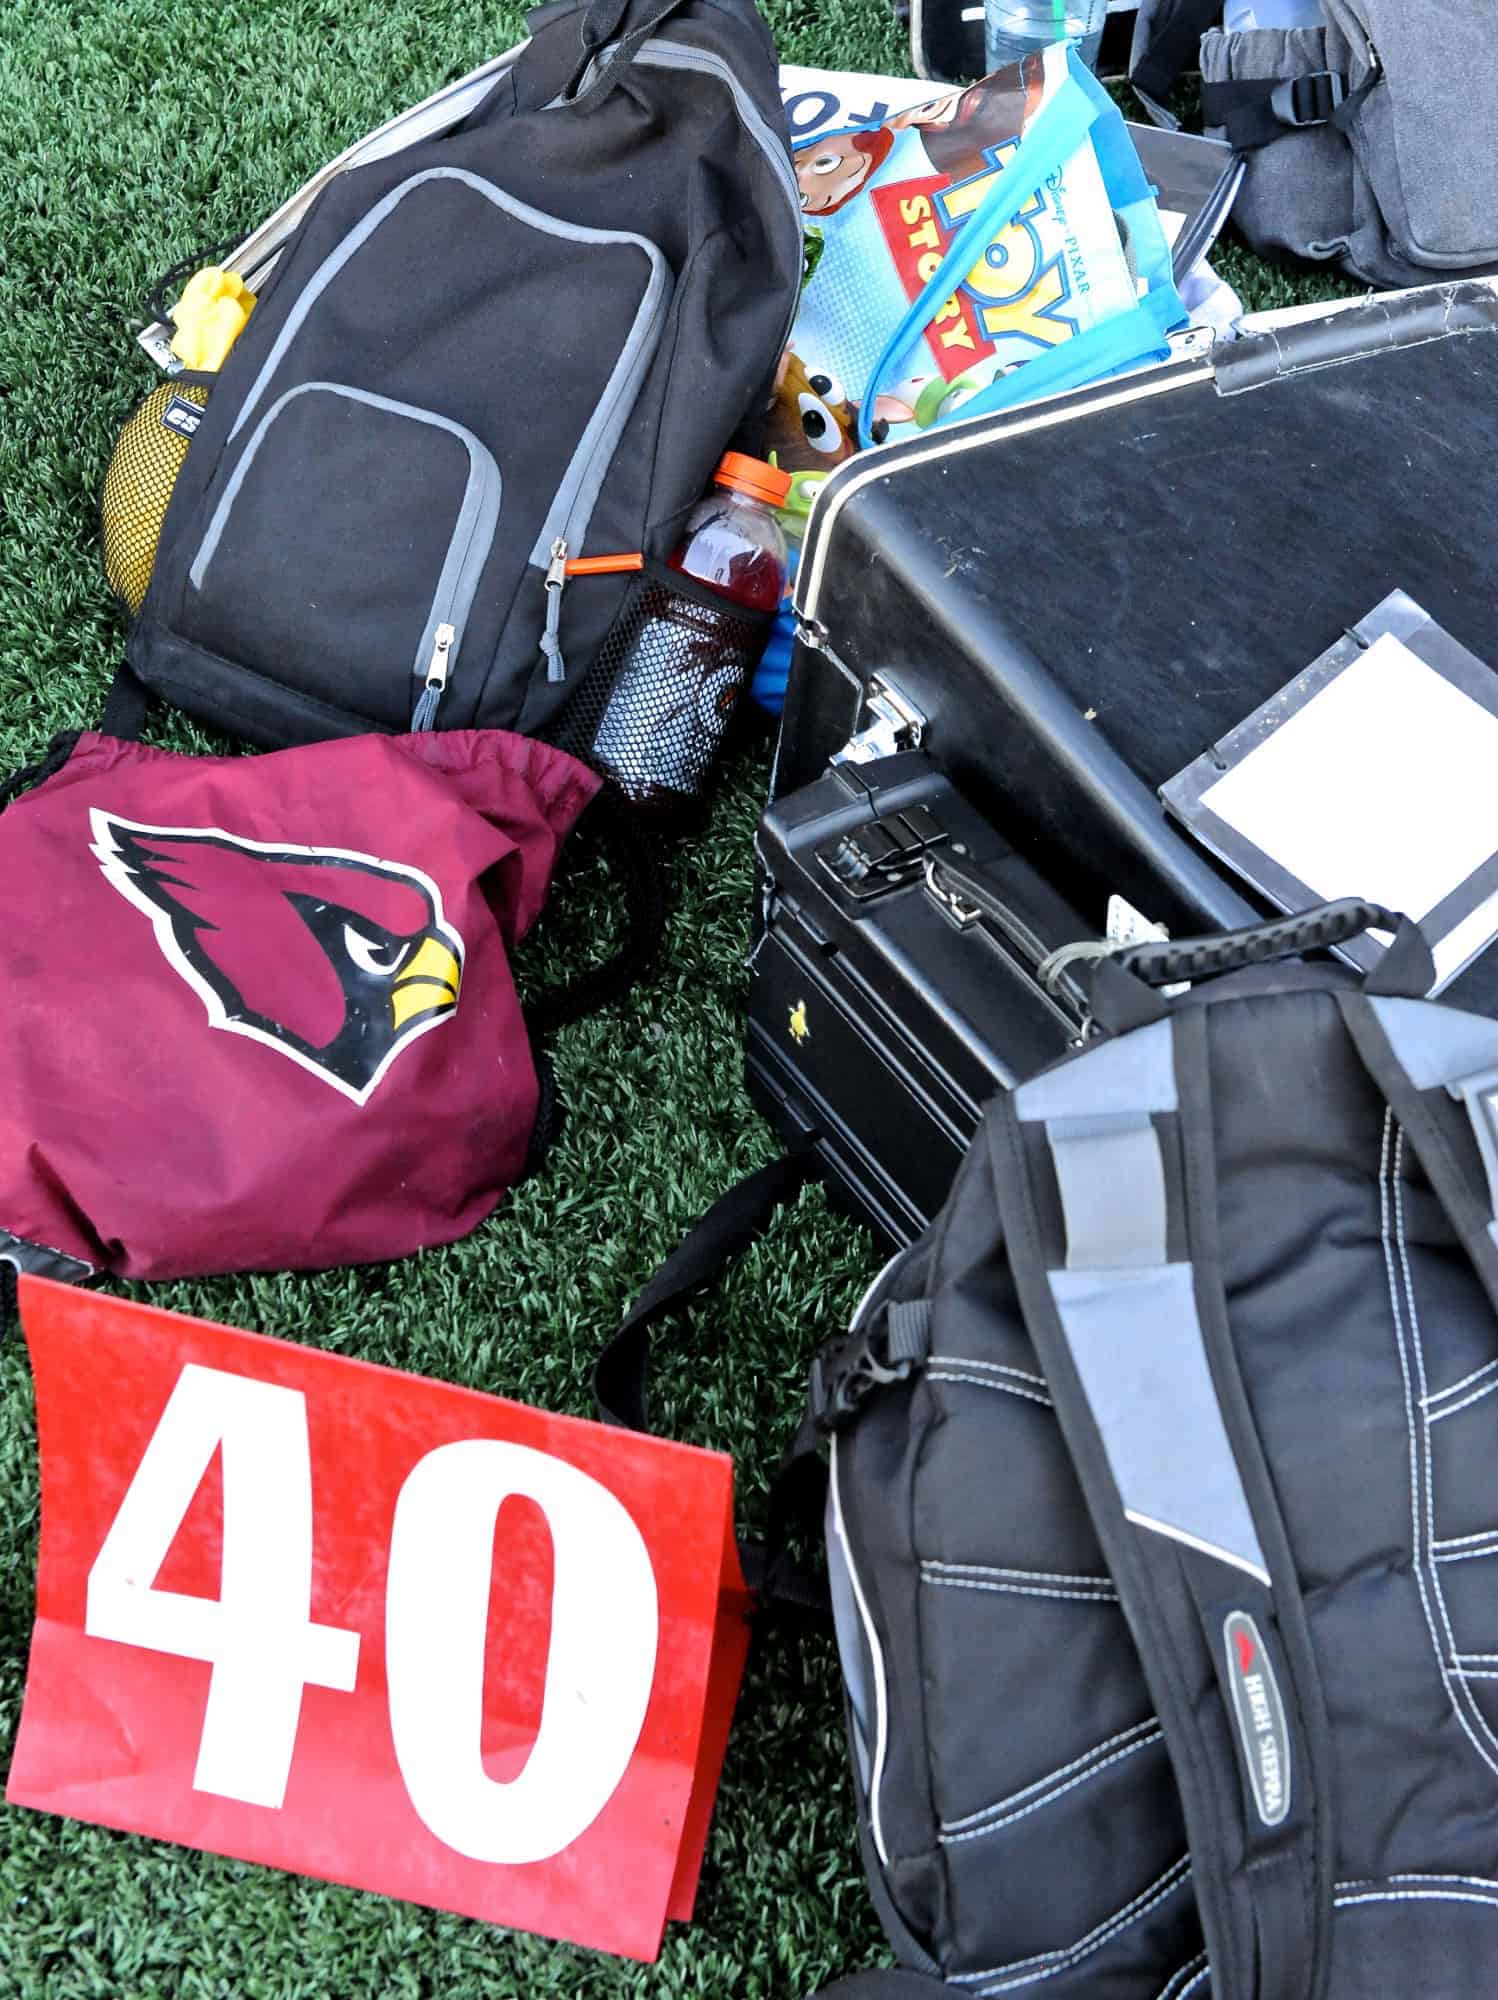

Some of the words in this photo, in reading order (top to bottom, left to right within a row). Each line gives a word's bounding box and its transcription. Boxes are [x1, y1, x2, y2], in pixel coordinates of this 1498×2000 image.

[1064, 234, 1091, 296] PIXAR
[85, 1362, 659, 1865] 40
[1243, 1672, 1273, 1732] HIGH
[1258, 1735, 1284, 1813] SIERRA
